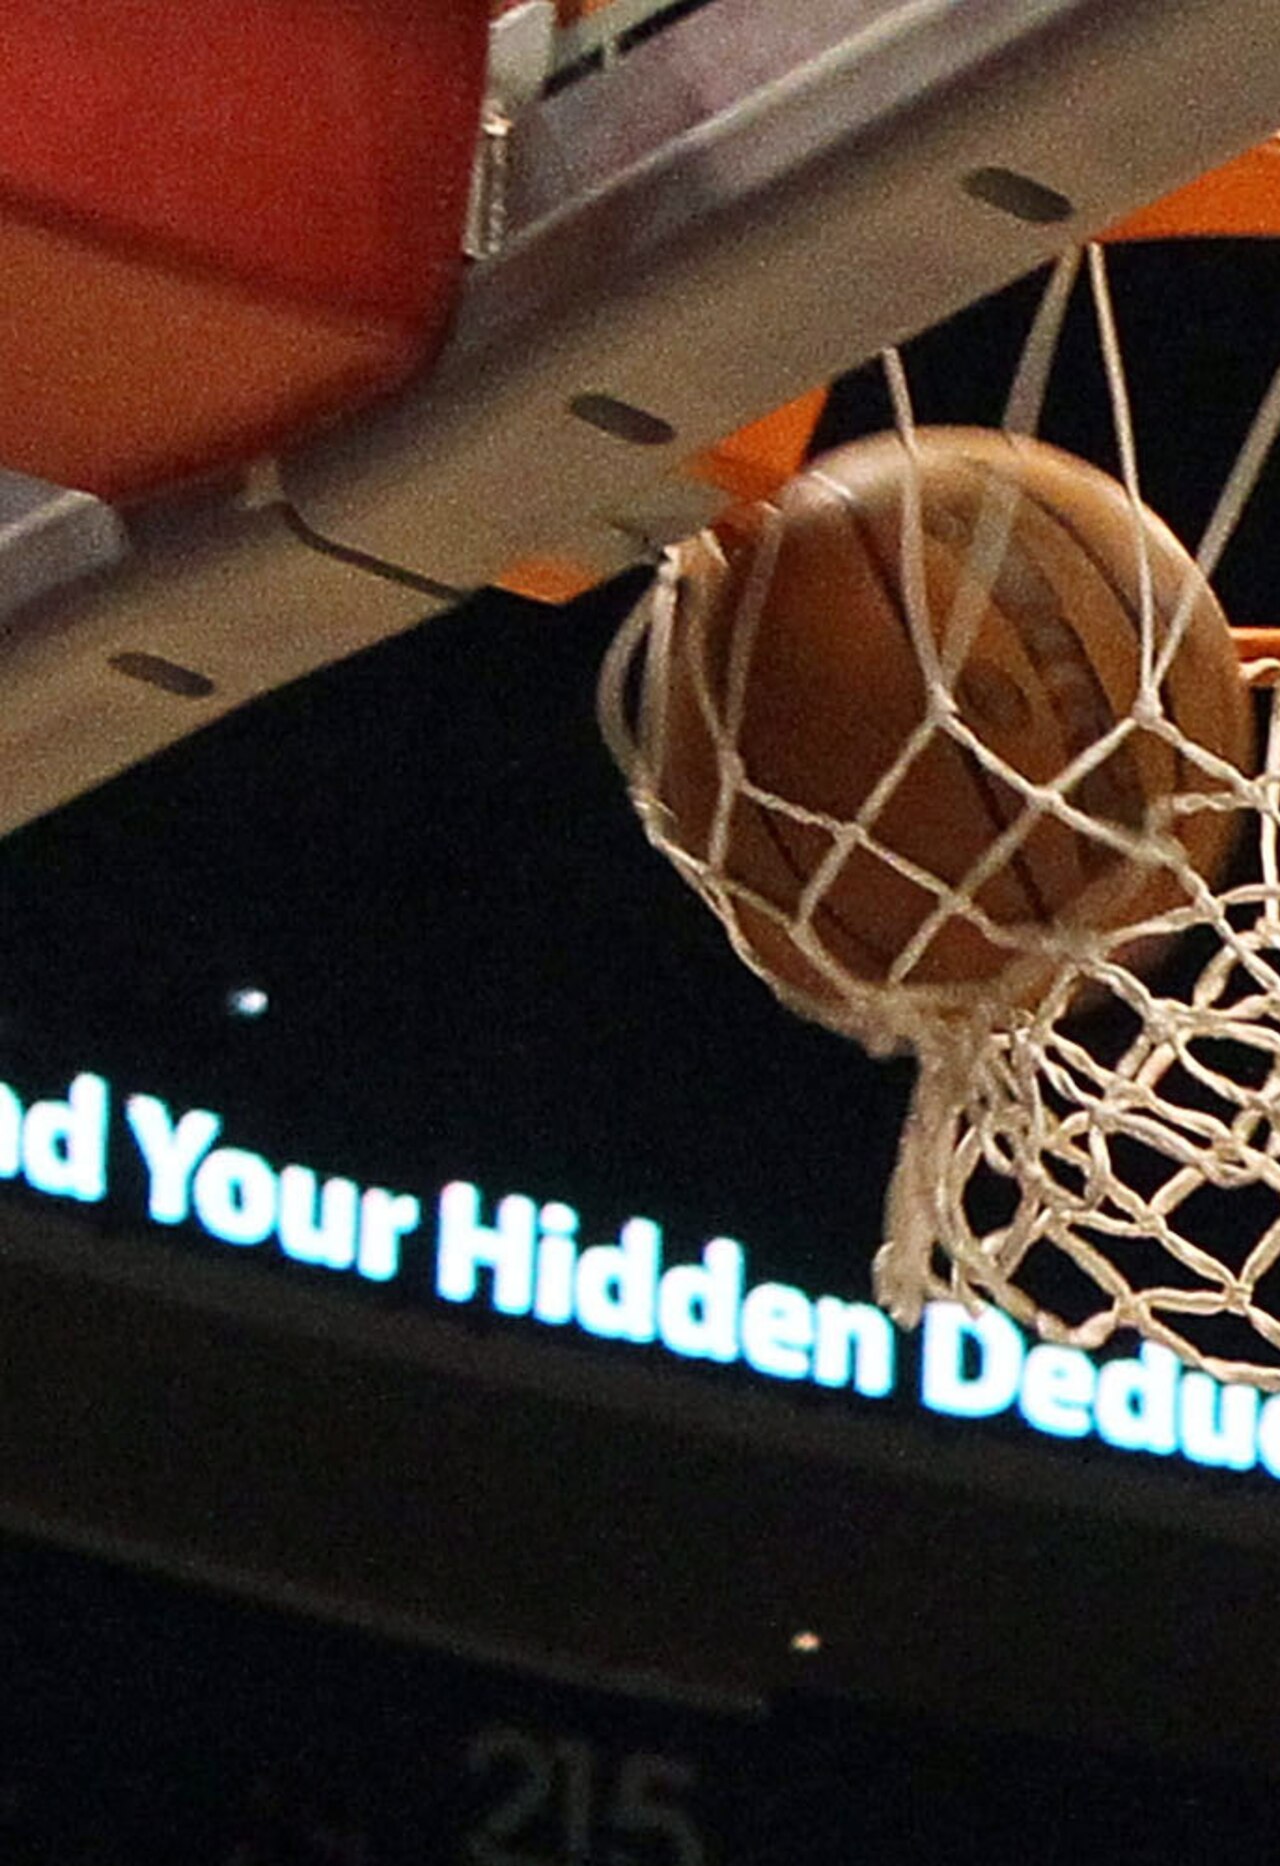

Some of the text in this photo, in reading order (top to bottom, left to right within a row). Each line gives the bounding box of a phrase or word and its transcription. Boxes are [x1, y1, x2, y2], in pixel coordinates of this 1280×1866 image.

[0, 1070, 109, 1203] d
[125, 1092, 421, 1283] Your
[436, 1180, 895, 1399] Hidden
